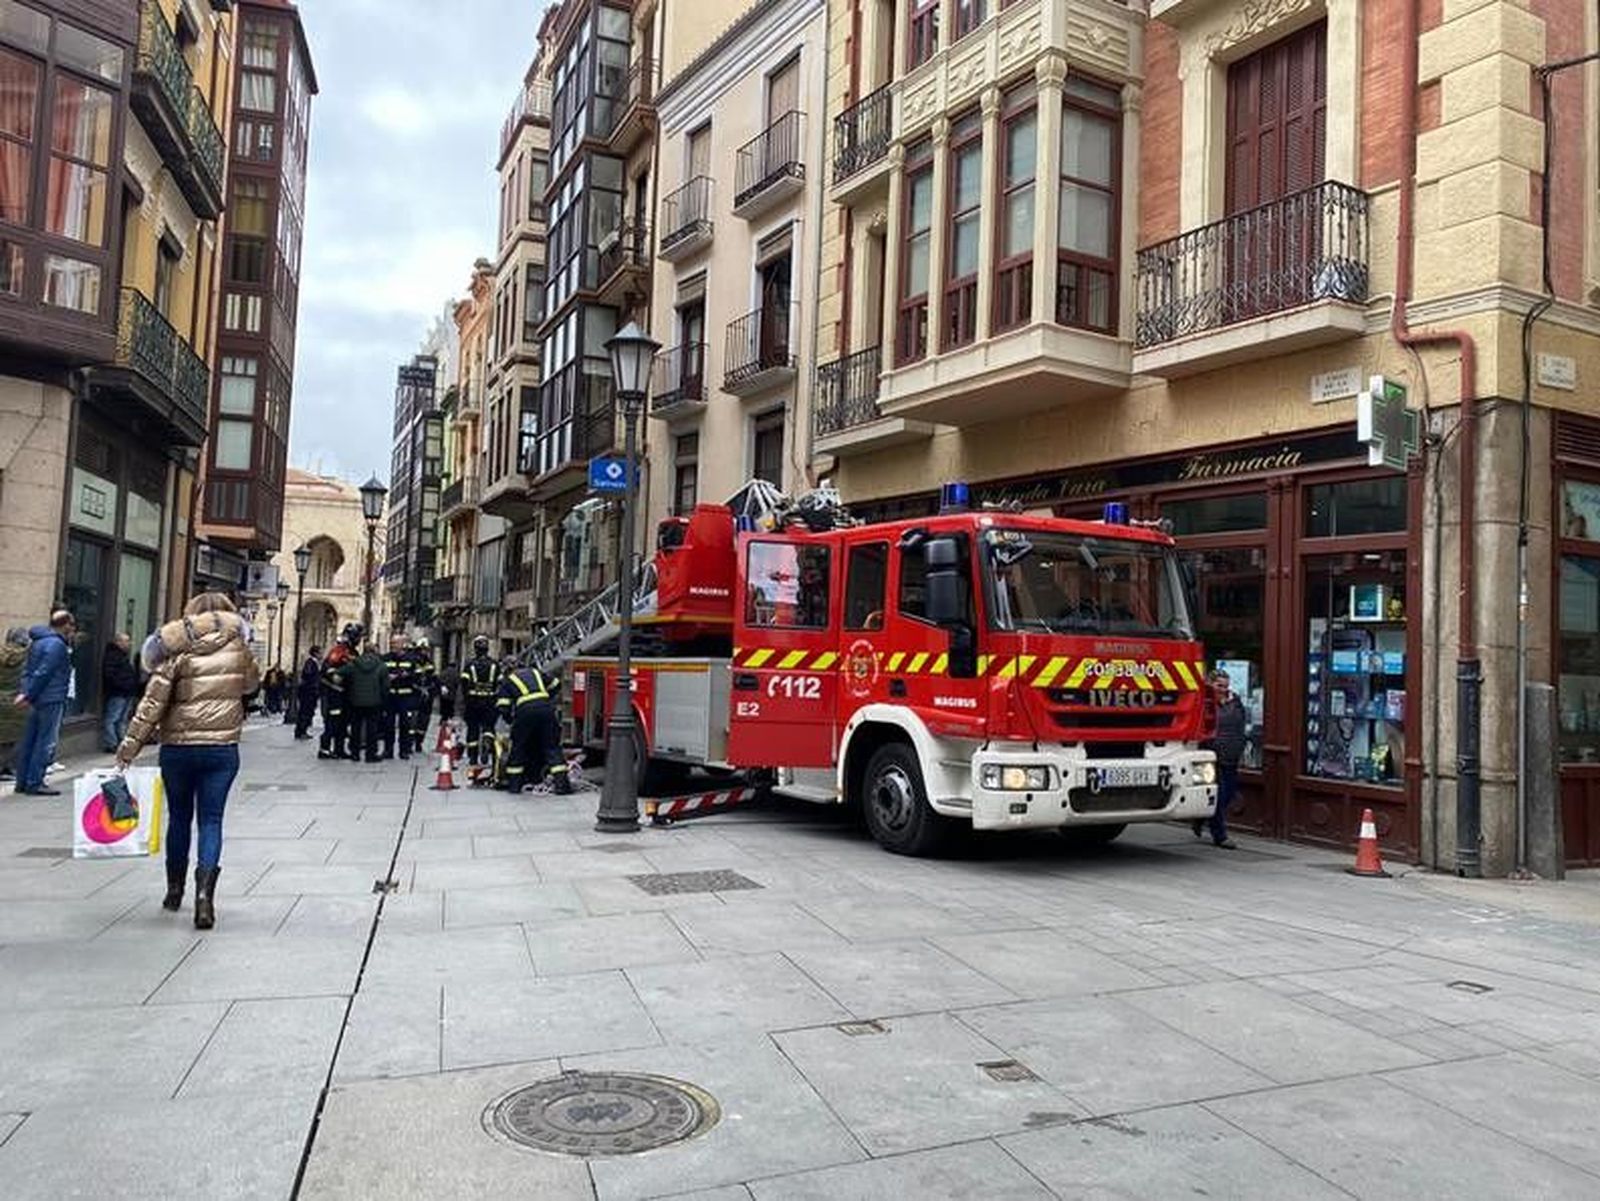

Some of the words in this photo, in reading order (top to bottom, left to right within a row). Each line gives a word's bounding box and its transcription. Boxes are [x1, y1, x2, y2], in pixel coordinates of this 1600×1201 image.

[1177, 446, 1304, 481] Farmacia
[782, 676, 821, 698] 112
[933, 695, 978, 709] MAGIRUS
[1089, 689, 1155, 708] IVECO
[736, 702, 759, 716] E2
